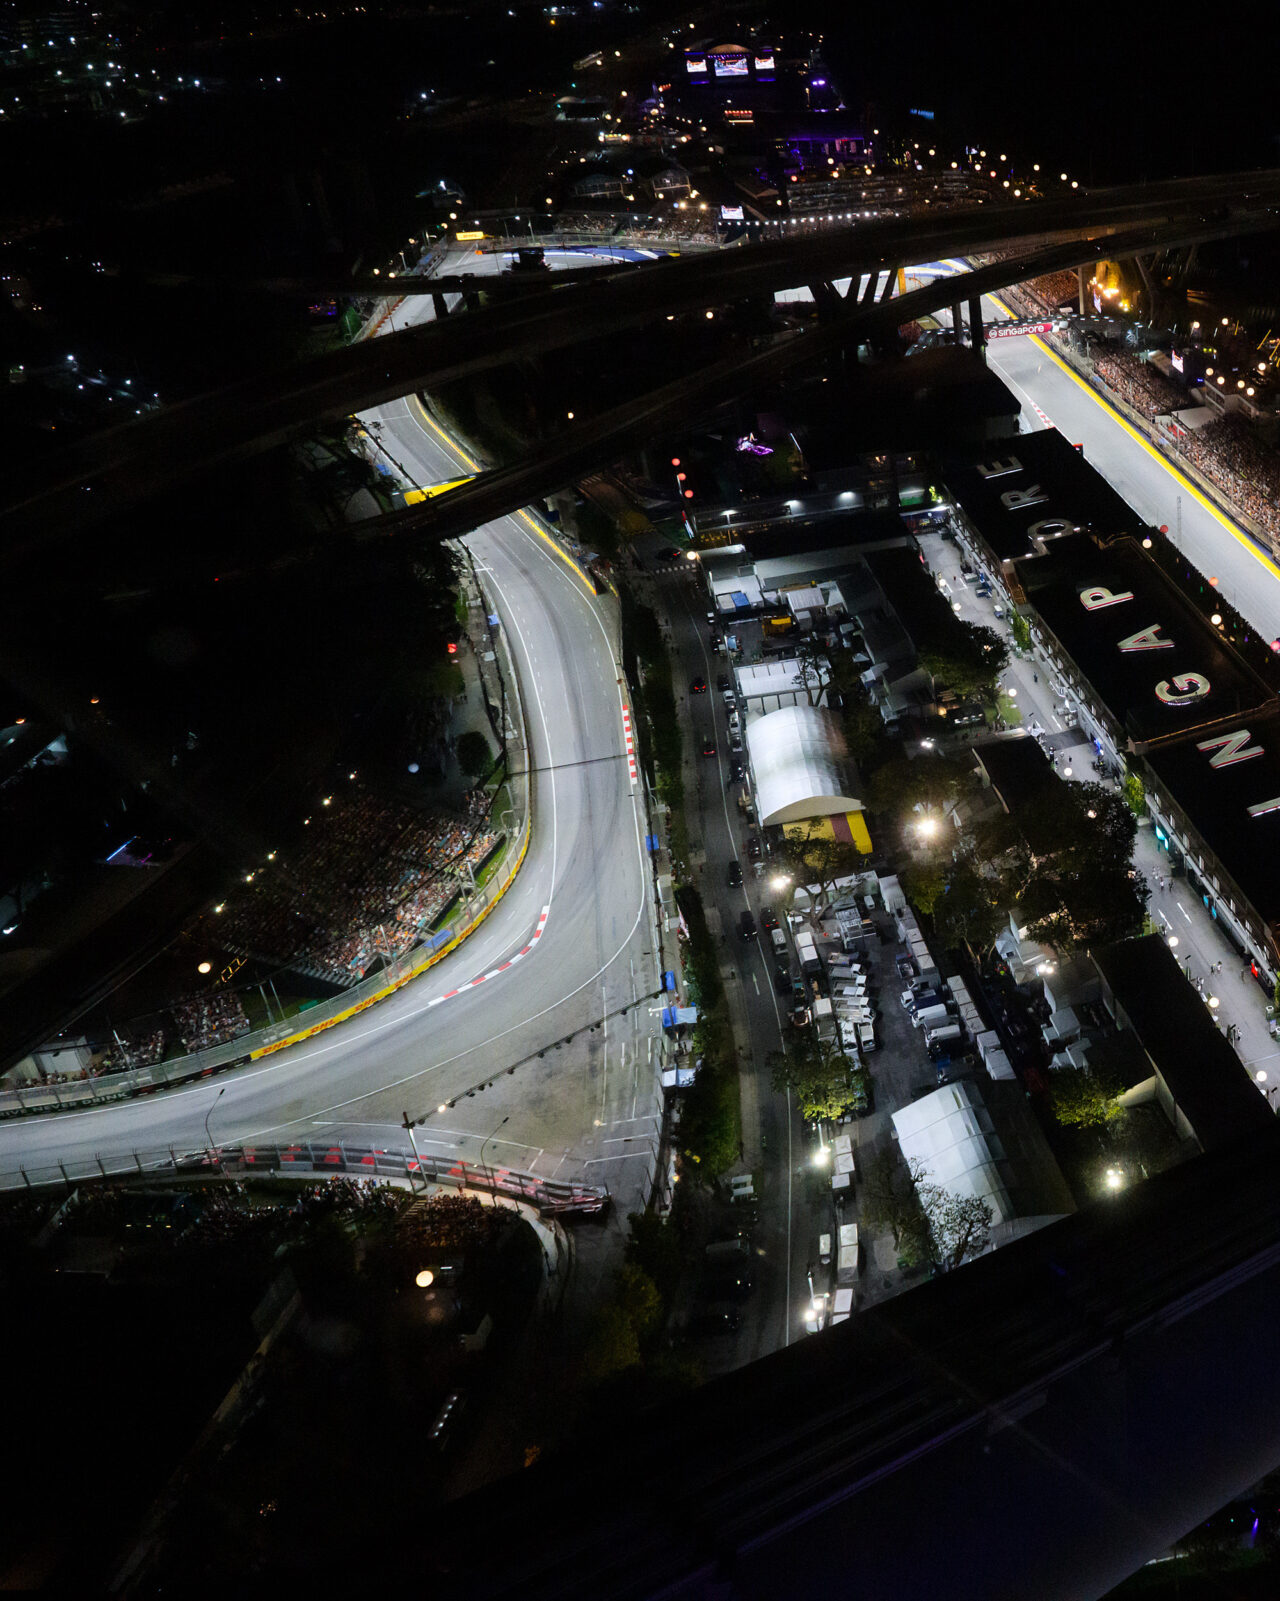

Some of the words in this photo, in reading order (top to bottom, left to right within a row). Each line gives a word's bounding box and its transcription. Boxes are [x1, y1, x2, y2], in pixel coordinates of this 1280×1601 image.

[354, 996, 377, 1012] DHL
[310, 1019, 336, 1034] DHL
[263, 1040, 289, 1055] DHL
[82, 1092, 128, 1105] DRINK
